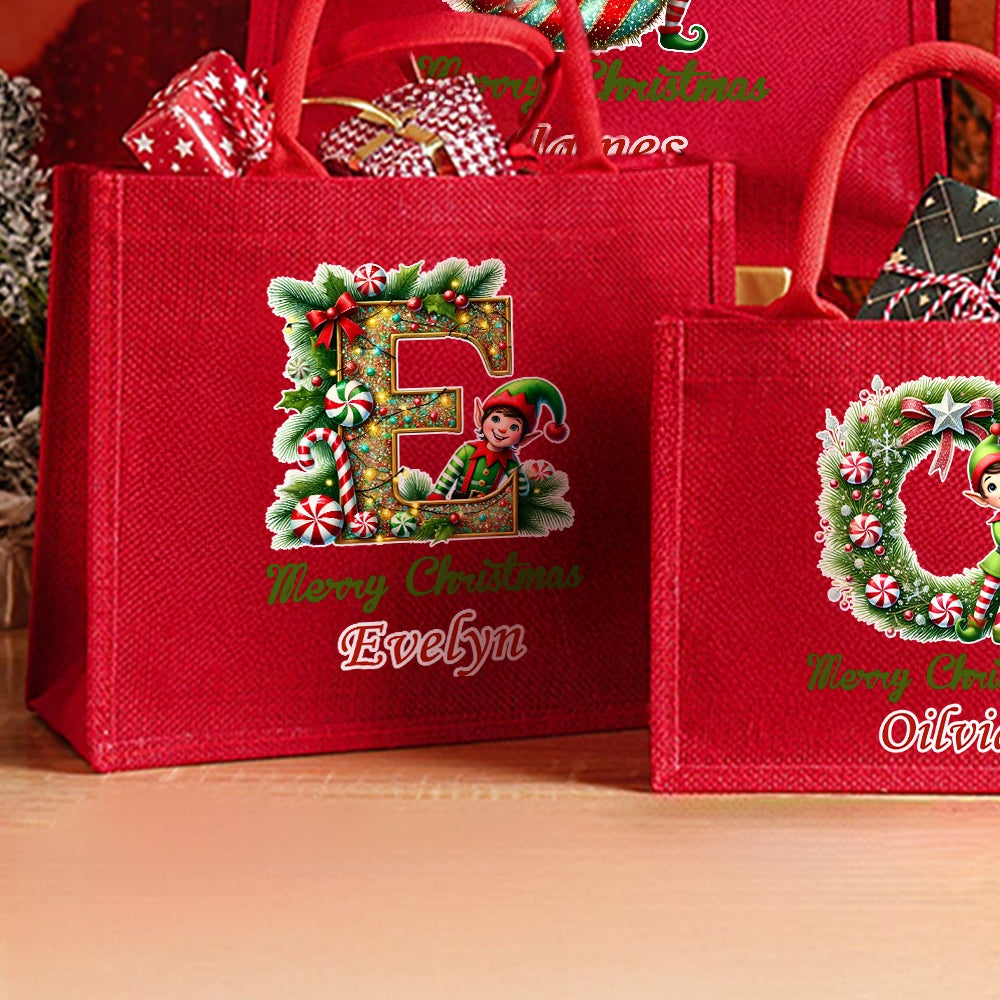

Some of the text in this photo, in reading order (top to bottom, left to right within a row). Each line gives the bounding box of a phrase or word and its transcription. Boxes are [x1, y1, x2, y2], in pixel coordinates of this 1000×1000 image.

[417, 55, 541, 114] Mrry
[266, 551, 584, 613] Merry Christmas
[337, 608, 528, 677] Evelyn
[806, 653, 914, 703] Merry
